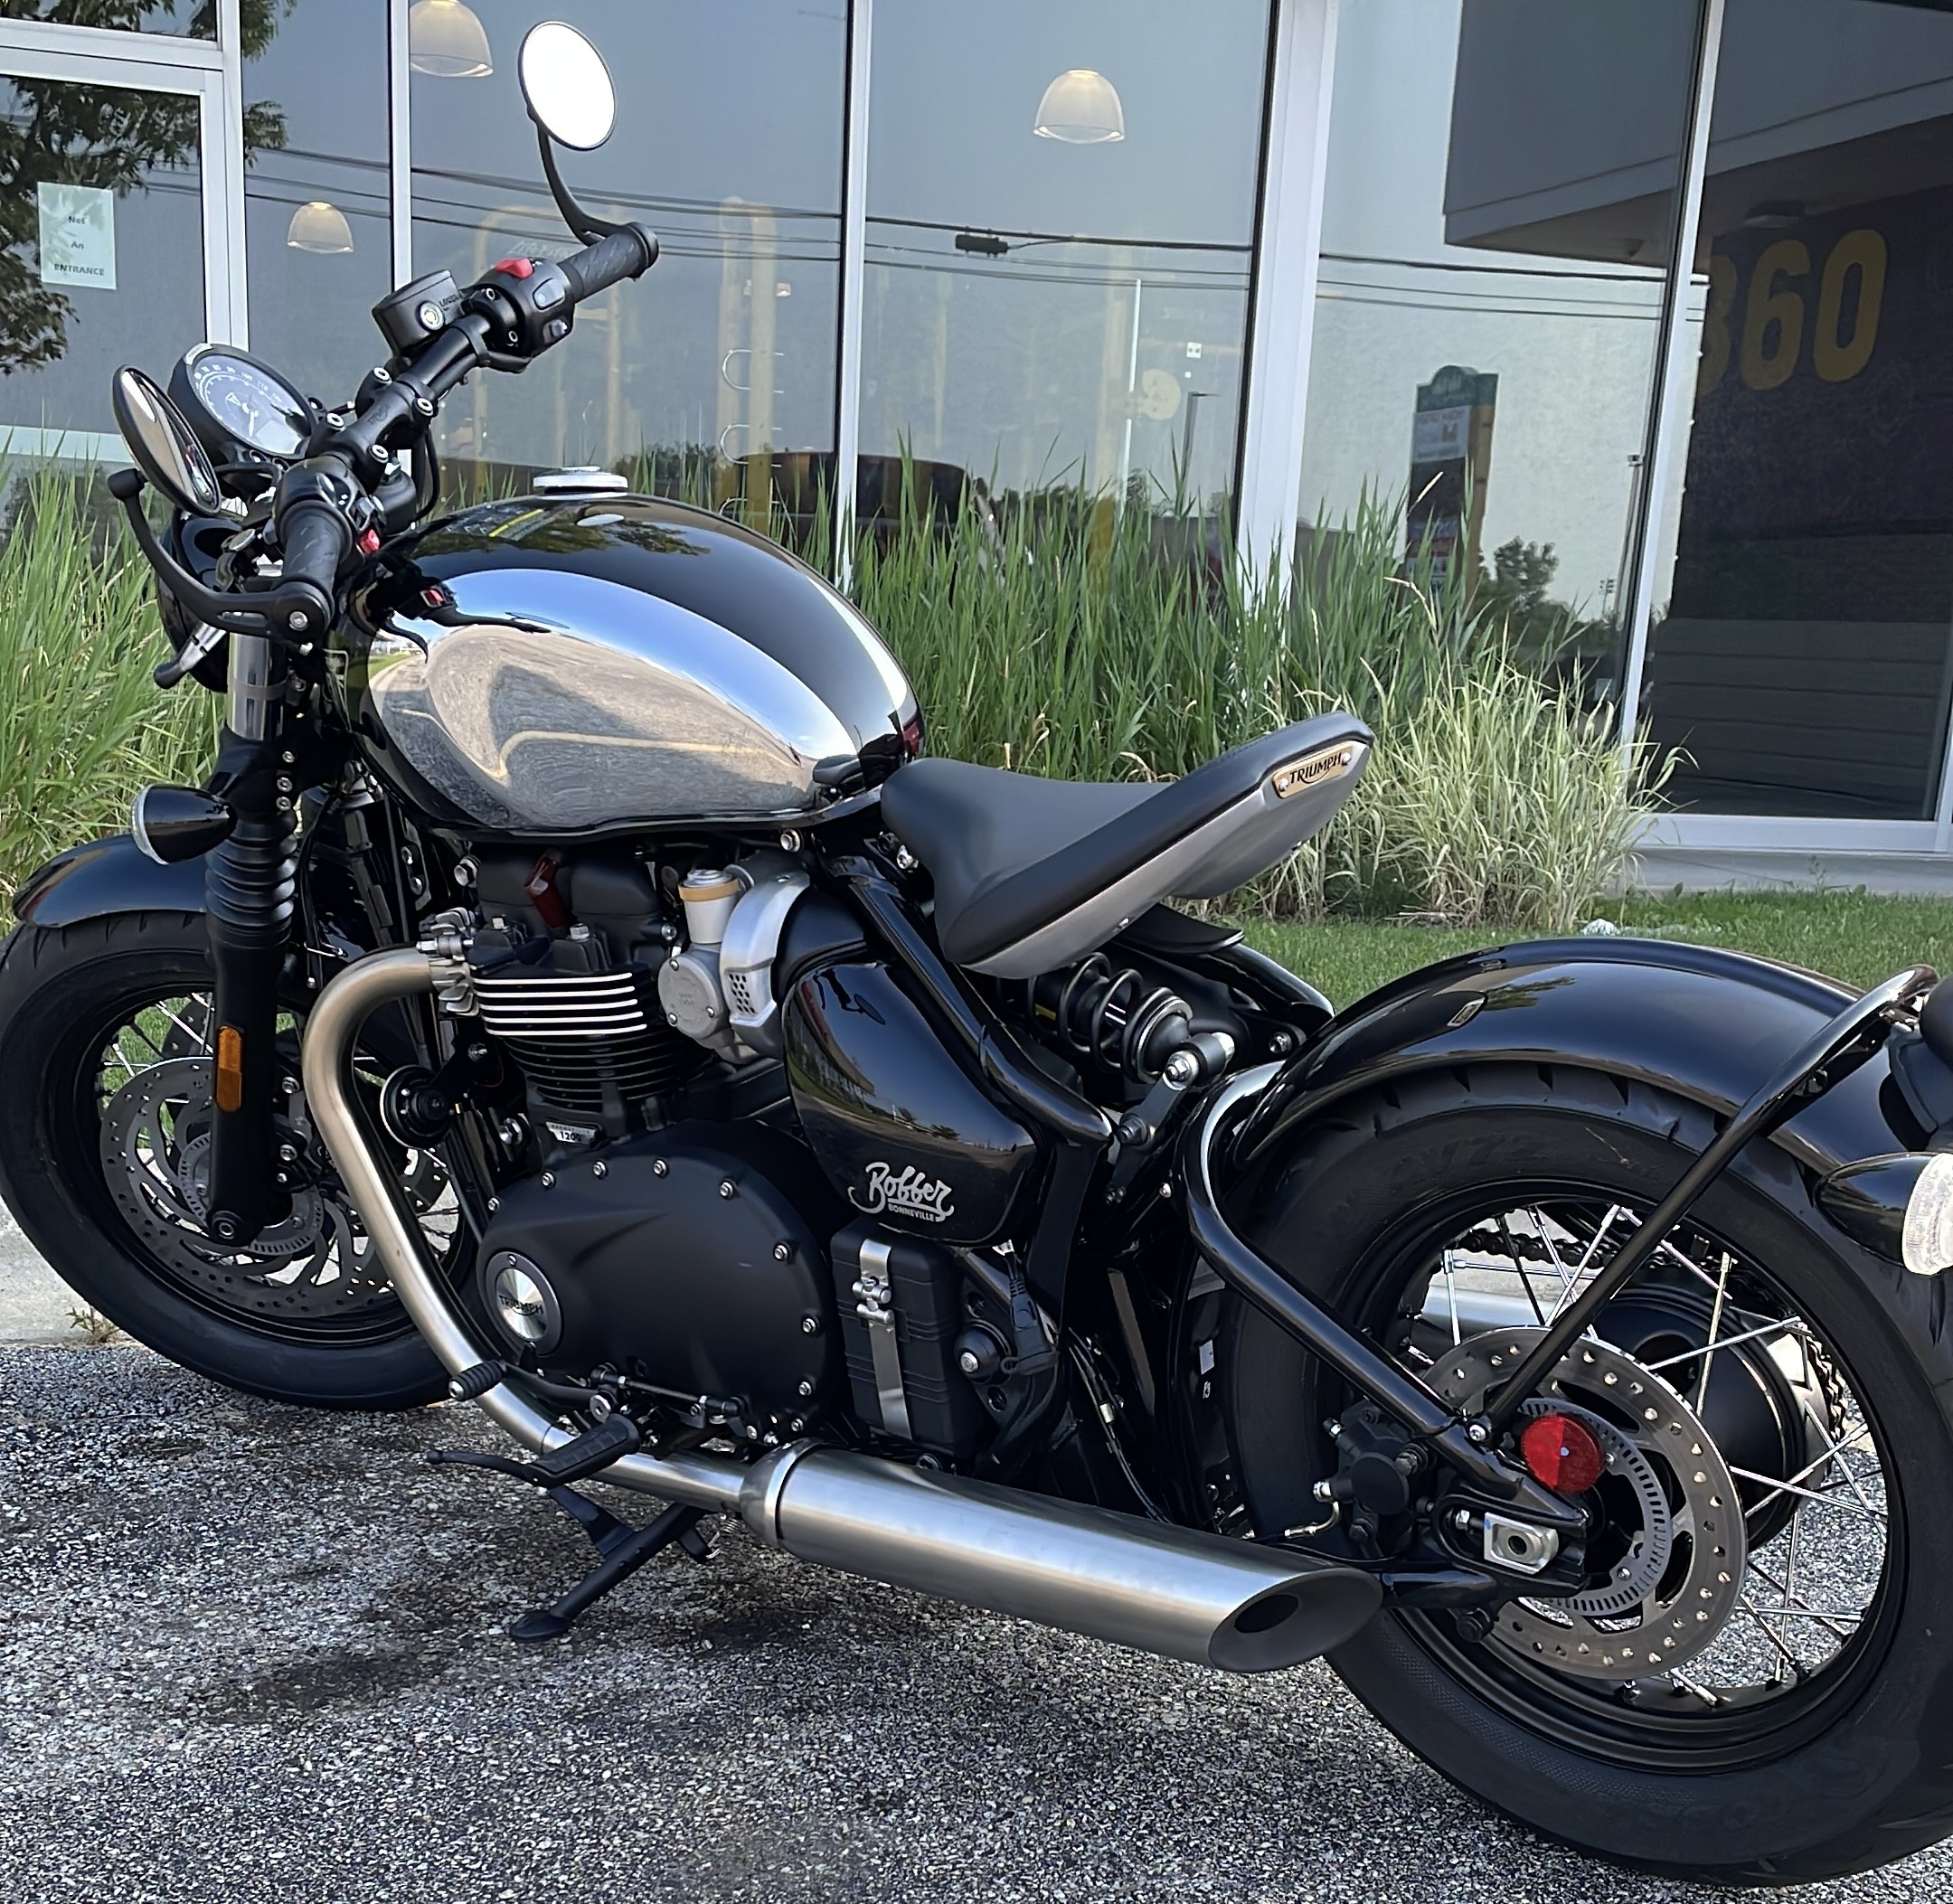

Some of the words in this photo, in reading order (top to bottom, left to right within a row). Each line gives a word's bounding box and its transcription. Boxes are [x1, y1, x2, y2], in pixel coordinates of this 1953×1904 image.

[68, 216, 86, 225] Not
[71, 241, 85, 250] An
[54, 264, 106, 277] ENTRANCE
[1289, 753, 1343, 785] TRIUMPH
[847, 1162, 955, 1222] Bobber
[887, 1203, 935, 1222] BONNEVILLE
[498, 1295, 544, 1316] TRIUMPH
